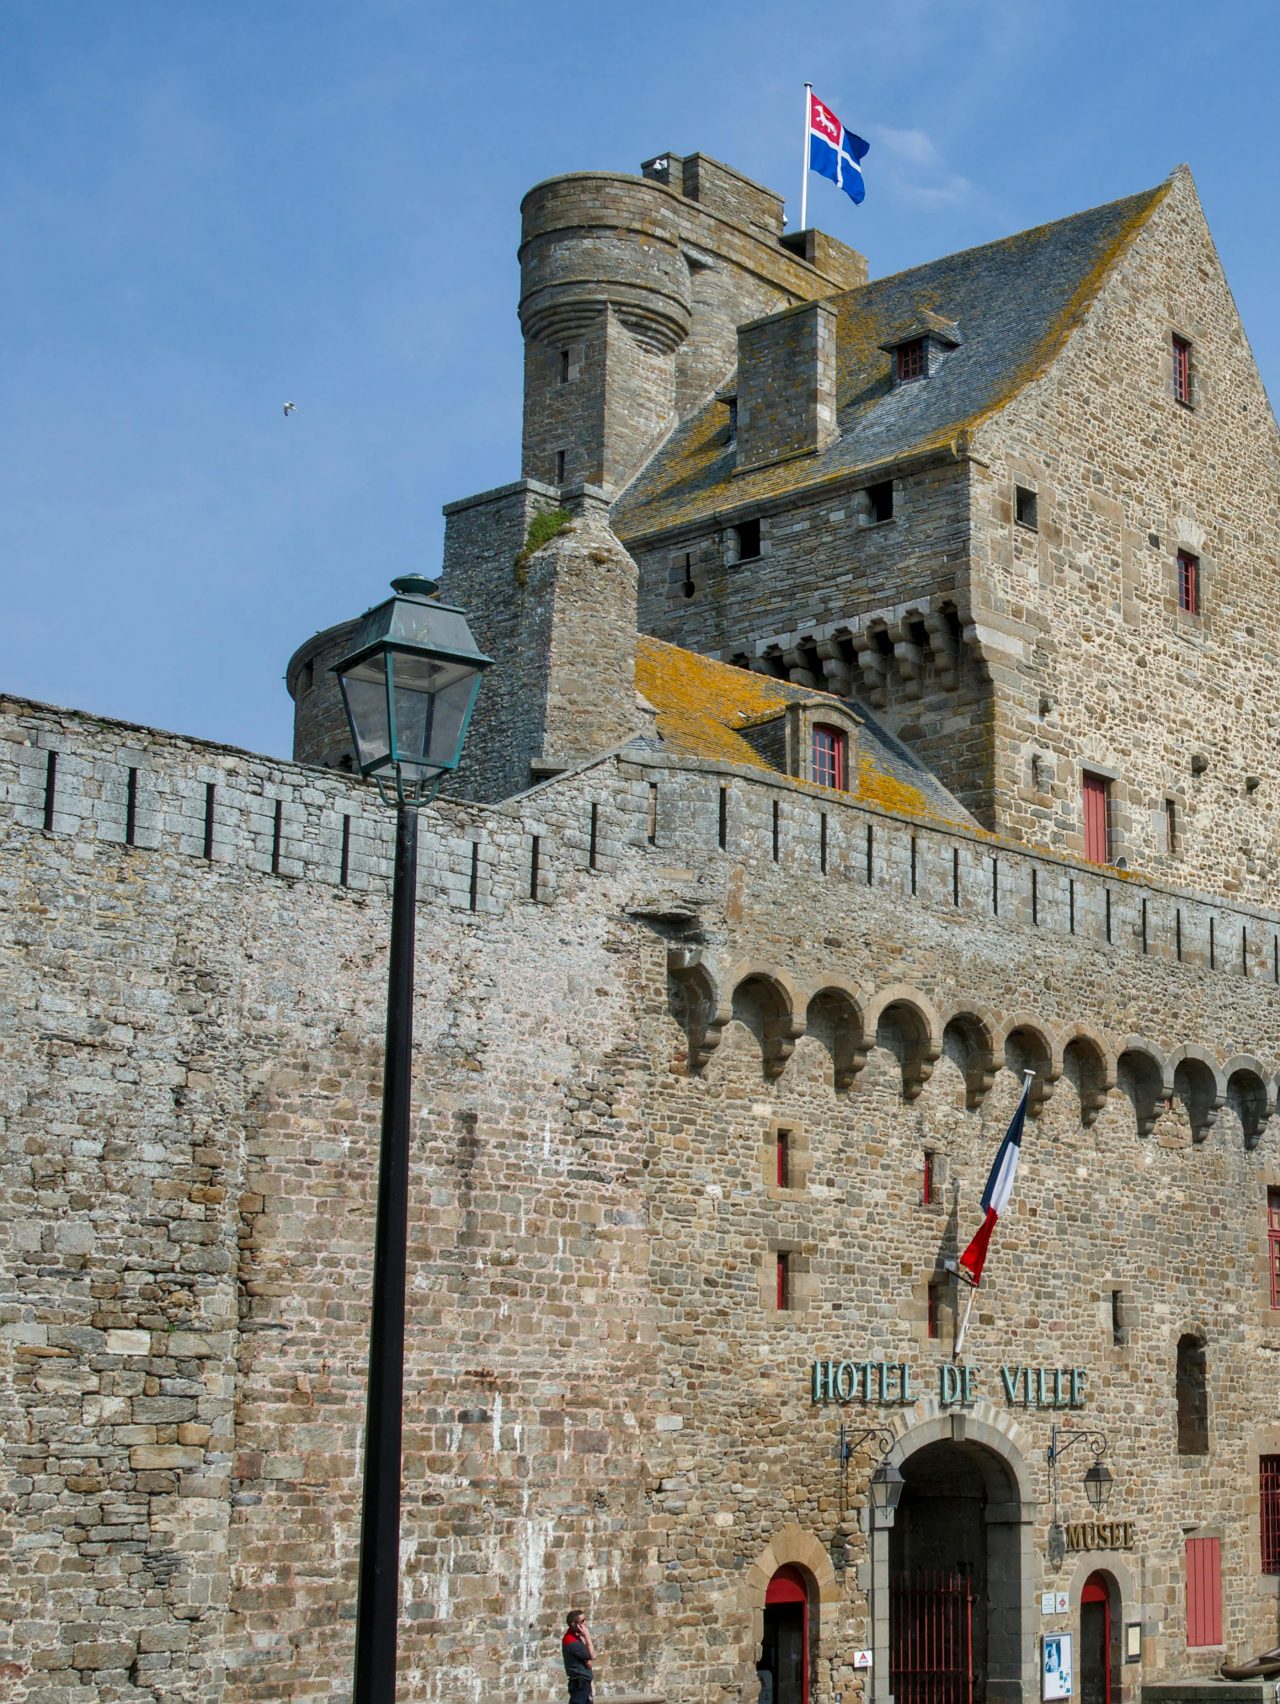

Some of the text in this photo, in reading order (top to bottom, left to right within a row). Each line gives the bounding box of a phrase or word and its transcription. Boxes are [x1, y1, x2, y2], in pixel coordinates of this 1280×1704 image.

[812, 1359, 1088, 1405] HOTEL DE VILLE
[1066, 1521, 1135, 1551] MUSEE
